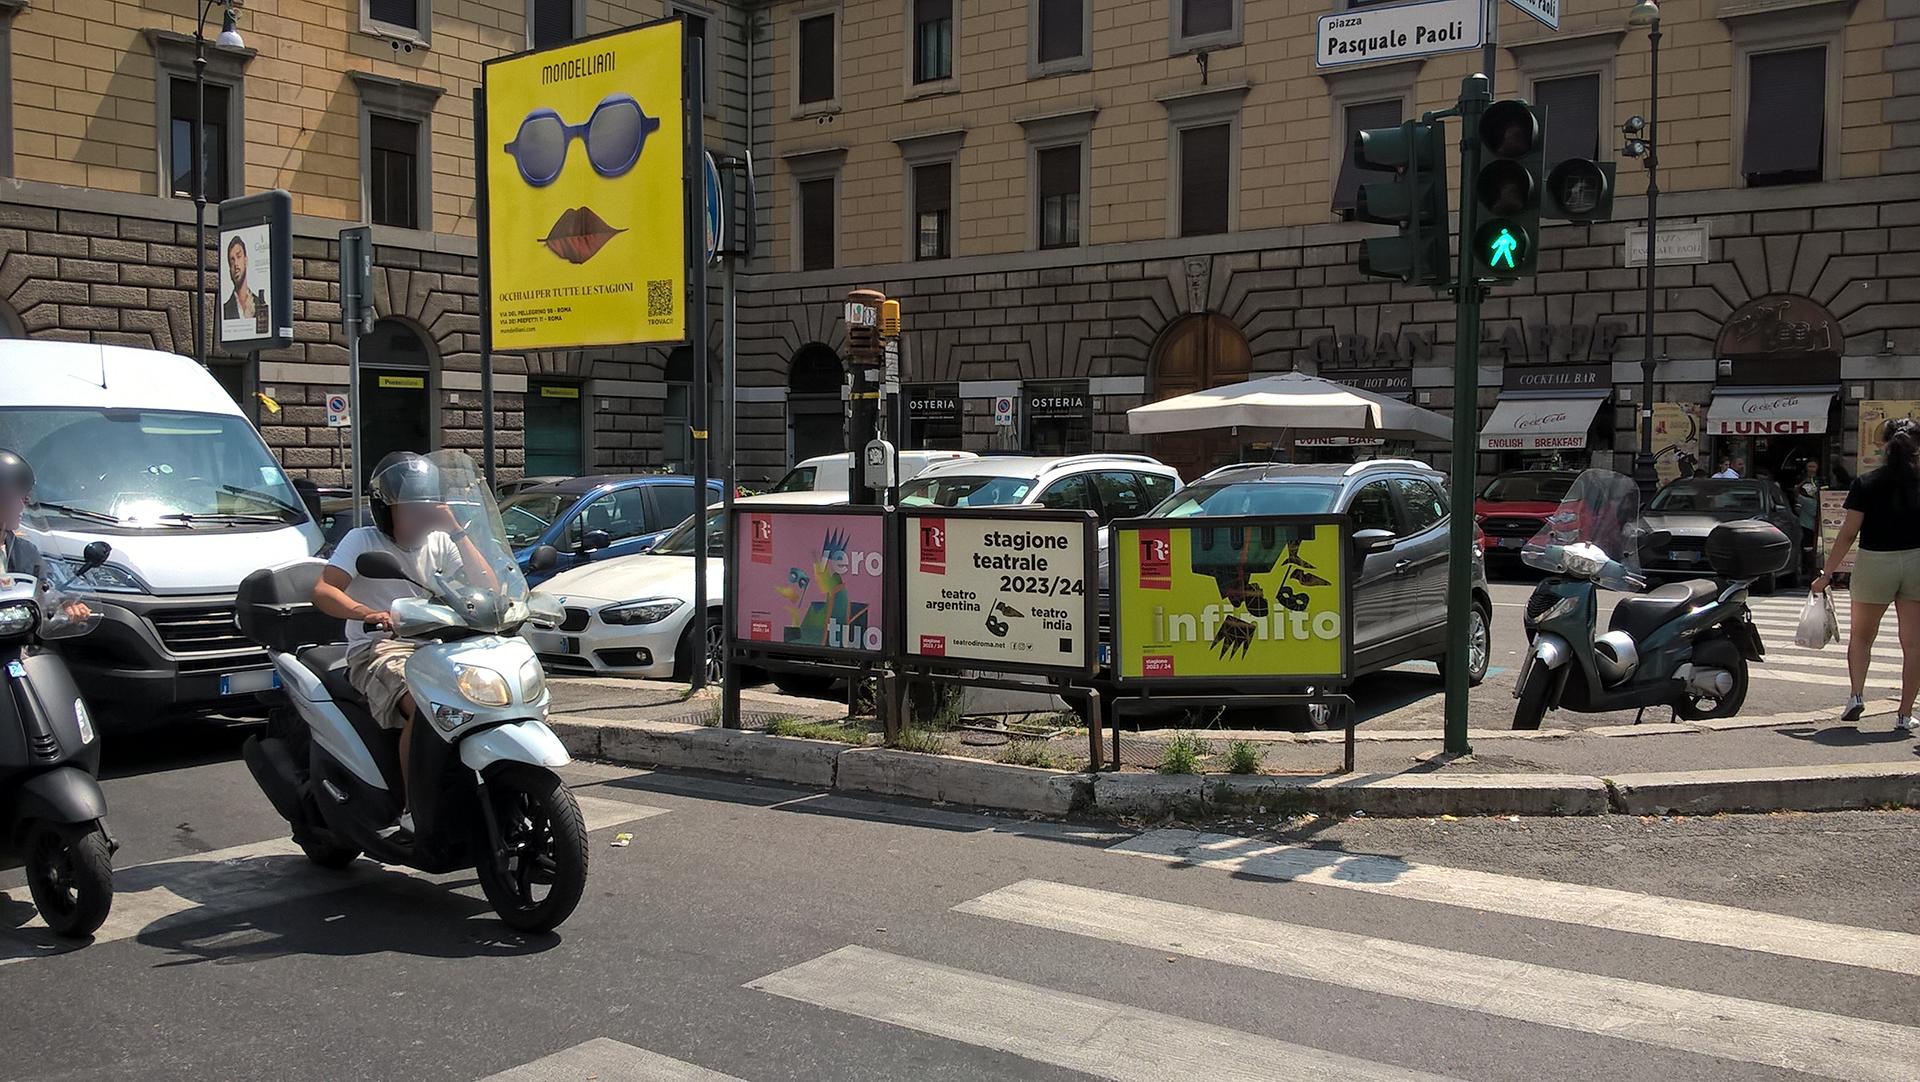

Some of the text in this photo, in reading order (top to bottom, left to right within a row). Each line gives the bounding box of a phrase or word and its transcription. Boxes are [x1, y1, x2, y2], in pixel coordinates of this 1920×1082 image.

[1328, 17, 1363, 31] piazza
[1327, 21, 1463, 56] Pasquale Paoli
[542, 51, 615, 85] MONDELLIANI
[499, 281, 634, 302] OCCHIALI PER TUTTE LE STAGIONI
[1310, 331, 1435, 363] GRAN
[1364, 378, 1384, 388] HOT
[1385, 376, 1408, 387] DOG
[1519, 372, 1596, 385] COCKTAIL BAR
[909, 400, 955, 409] OSTERIA
[1031, 397, 1083, 408] OSTERIA
[1721, 420, 1810, 434] LUNCH
[1488, 437, 1583, 448] ENGLISH BREAKFAST
[984, 531, 1069, 551] stagione
[973, 552, 1048, 571] teatrale
[1000, 575, 1085, 597] 2023/24
[941, 588, 977, 600] teatro
[925, 600, 981, 612] argentina
[1031, 607, 1068, 619] teatro
[1043, 619, 1073, 631] india
[827, 617, 883, 651] tuo
[953, 639, 1006, 649] teatrodiroma.net
